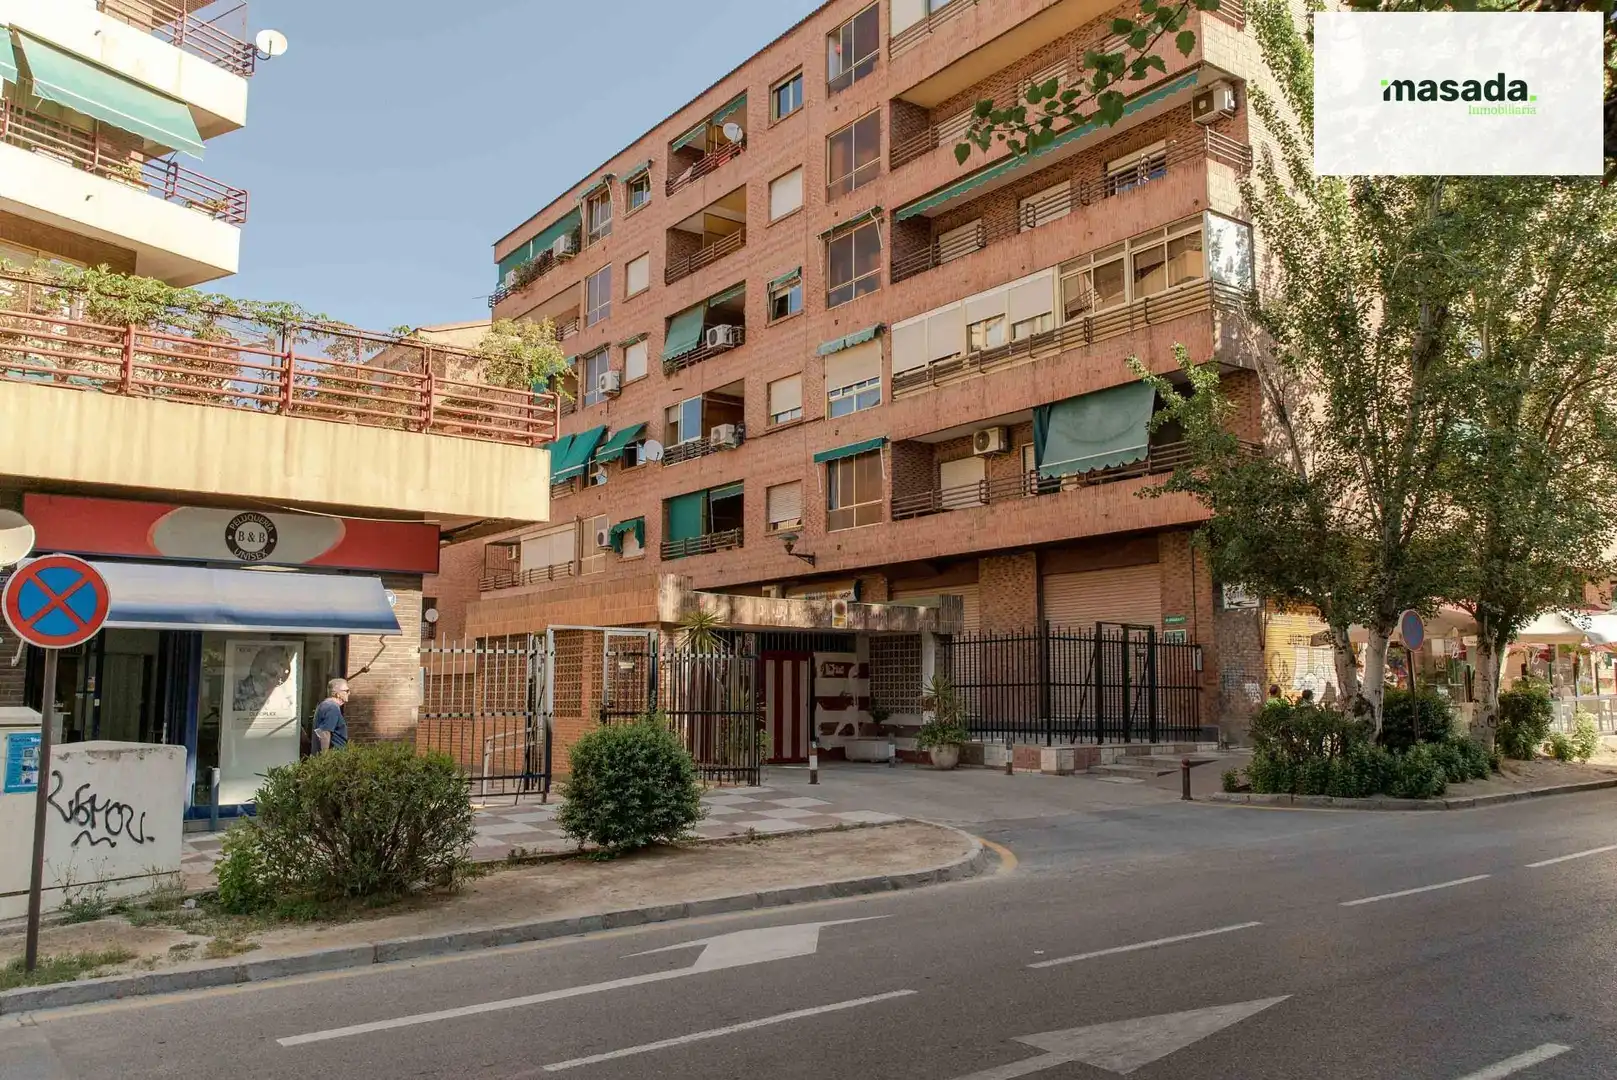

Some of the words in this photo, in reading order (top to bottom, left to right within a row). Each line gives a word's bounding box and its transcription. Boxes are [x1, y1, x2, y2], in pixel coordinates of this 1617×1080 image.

[237, 530, 245, 542] B
[247, 531, 256, 543] &
[258, 532, 266, 543] B
[233, 547, 268, 561] UNISEX
